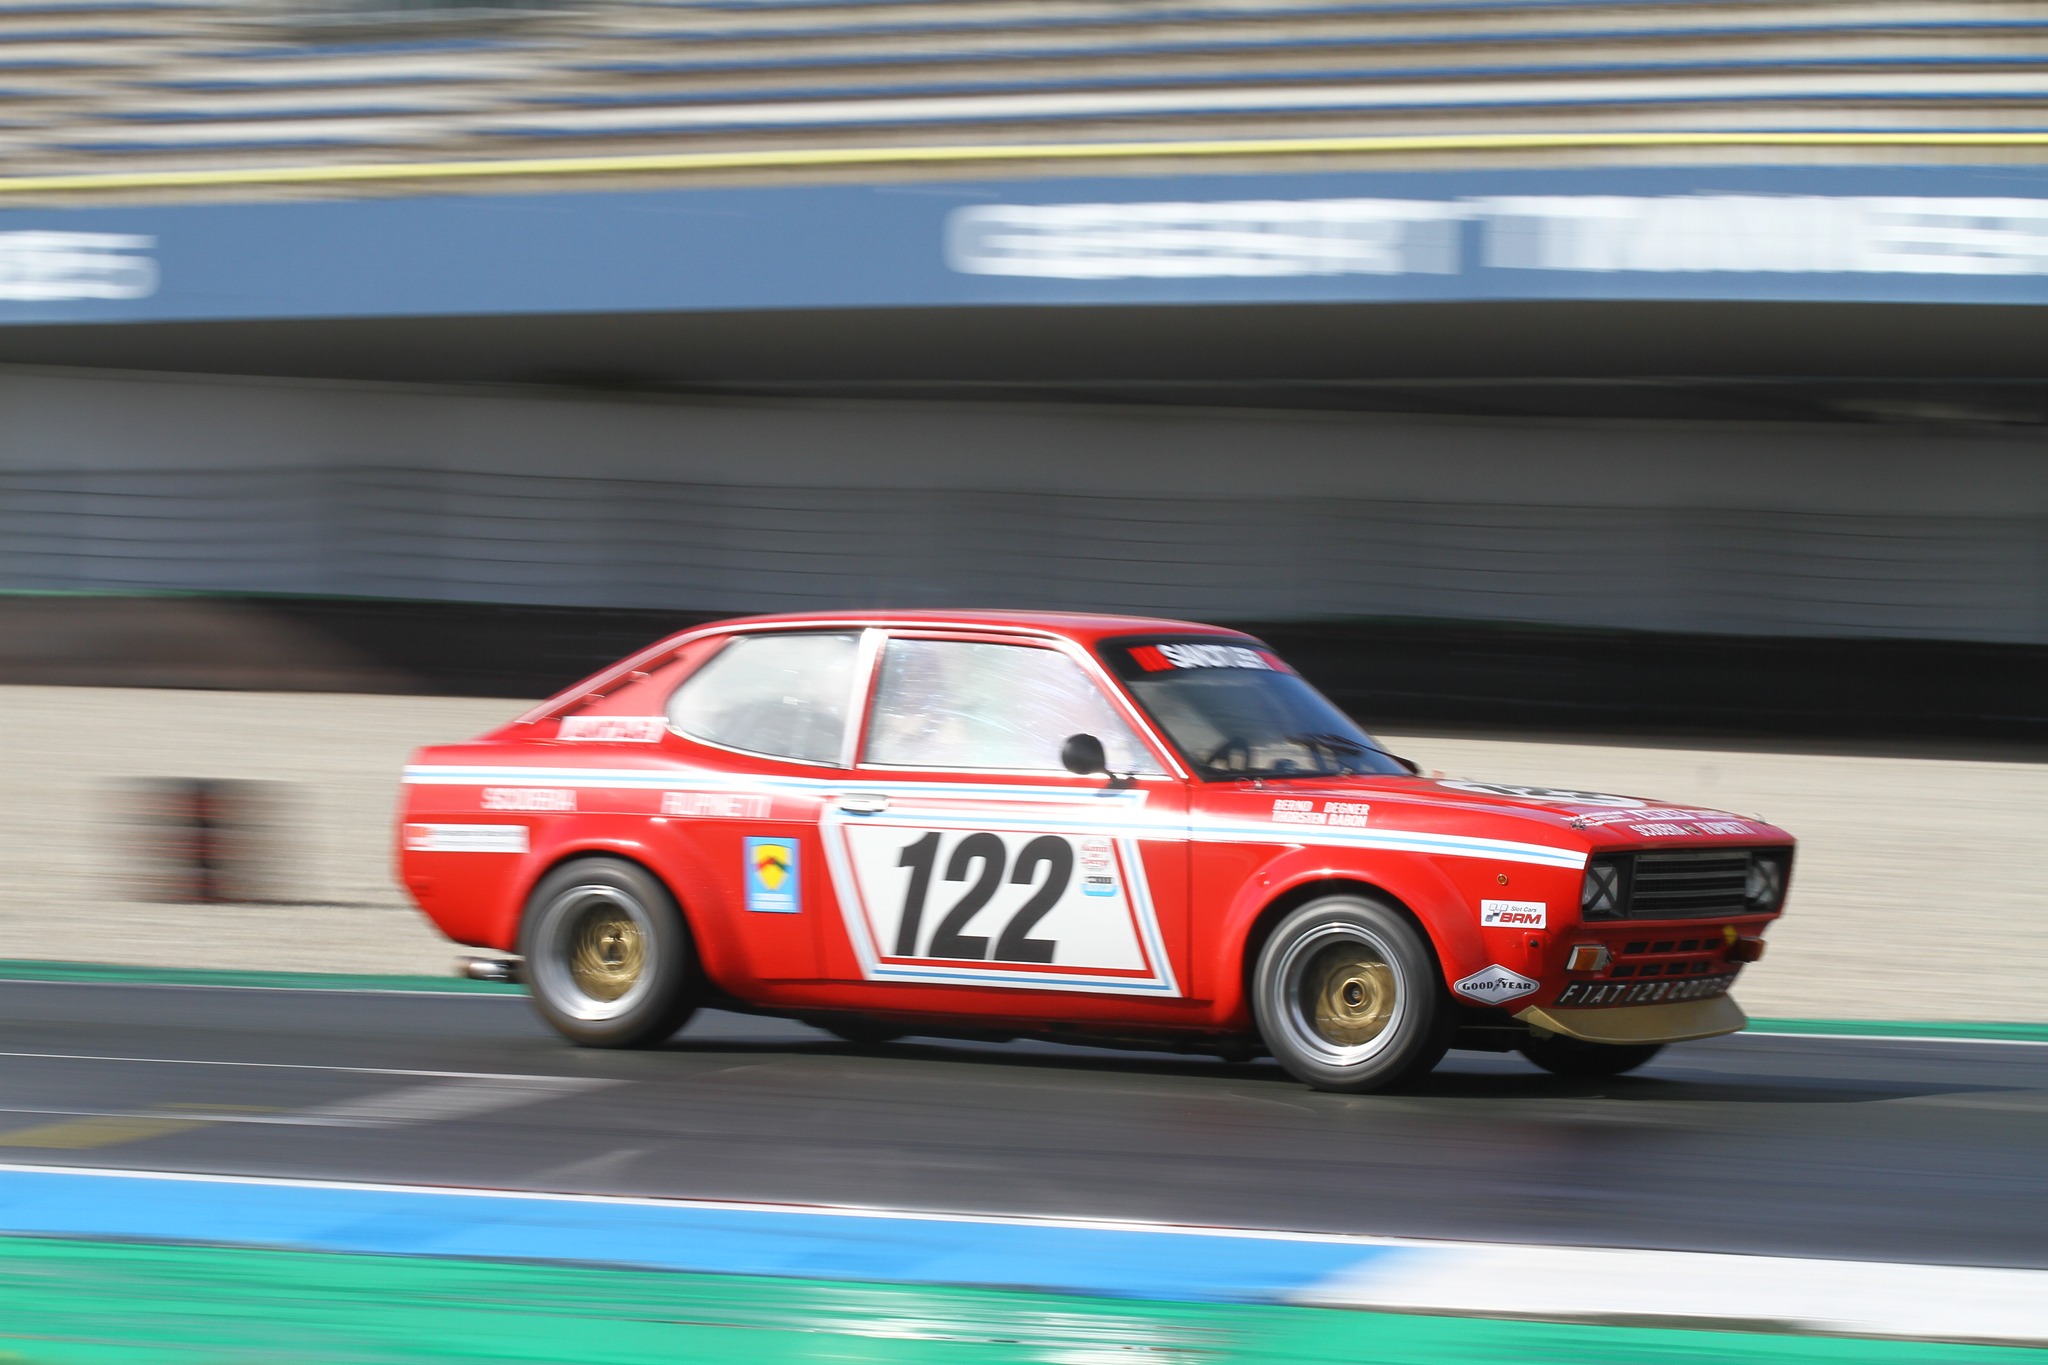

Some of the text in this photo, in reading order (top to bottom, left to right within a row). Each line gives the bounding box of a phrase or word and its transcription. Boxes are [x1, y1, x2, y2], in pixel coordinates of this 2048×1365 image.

[893, 831, 1074, 964] 122
[1499, 912, 1543, 925] BRM
[1560, 984, 1626, 1004] FIAT
[1625, 981, 1671, 1002] 128
